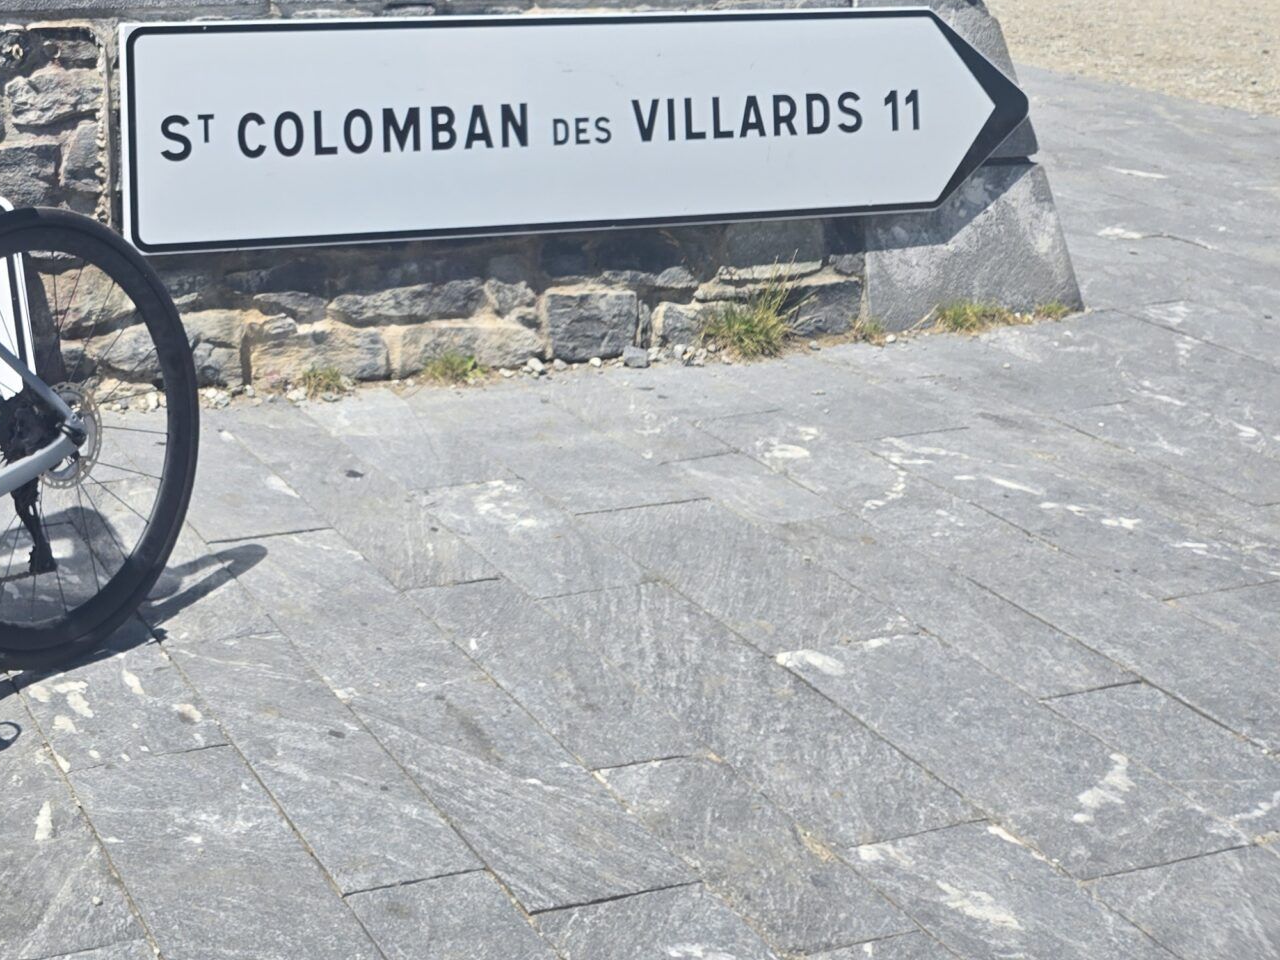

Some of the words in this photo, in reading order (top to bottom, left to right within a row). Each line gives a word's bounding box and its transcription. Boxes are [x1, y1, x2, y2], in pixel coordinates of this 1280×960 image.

[237, 102, 529, 159] COLOMBAN
[553, 116, 612, 146] DES
[631, 91, 863, 142] VILLARDS
[884, 89, 921, 132] 11
